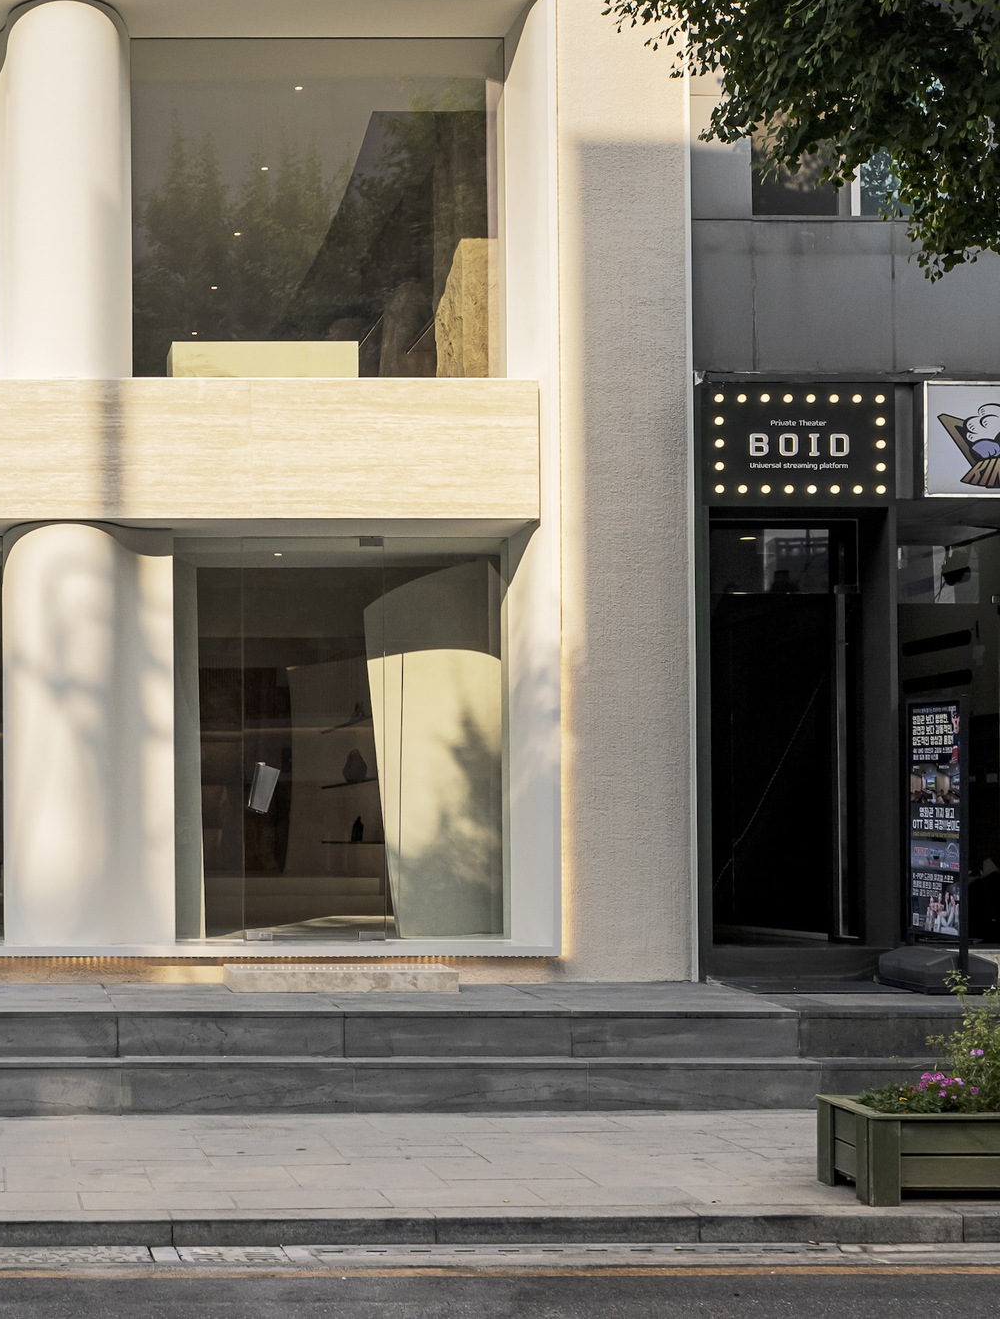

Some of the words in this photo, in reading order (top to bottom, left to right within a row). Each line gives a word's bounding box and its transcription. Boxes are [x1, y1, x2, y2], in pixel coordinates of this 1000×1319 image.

[770, 419, 797, 427] Private
[798, 419, 827, 427] Theater
[749, 432, 850, 457] BOID
[783, 462, 818, 470] streaming
[819, 462, 849, 470] platform
[913, 819, 923, 829] OTT
